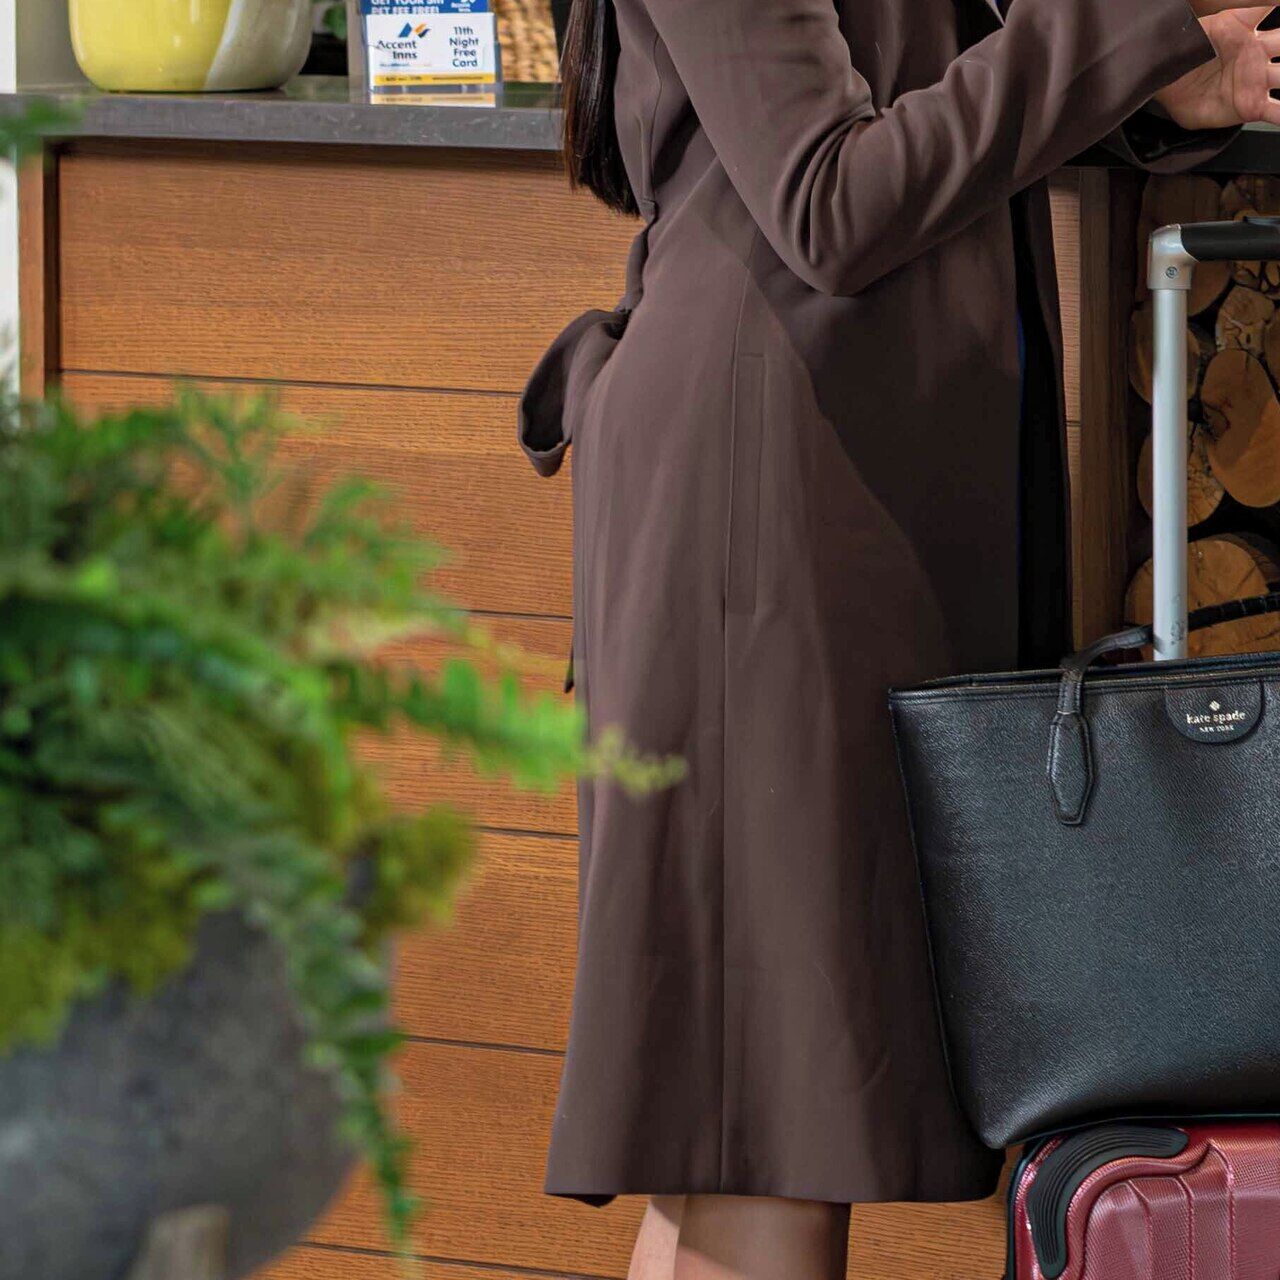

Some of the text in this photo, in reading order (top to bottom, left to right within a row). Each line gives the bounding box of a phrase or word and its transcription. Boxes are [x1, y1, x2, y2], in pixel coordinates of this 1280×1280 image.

[453, 26, 473, 36] 11th
[377, 40, 417, 50] Accent
[449, 38, 479, 48] Night
[393, 51, 418, 60] Inns
[453, 49, 477, 58] Free
[452, 59, 478, 68] Card
[1186, 710, 1246, 725] kate spade
